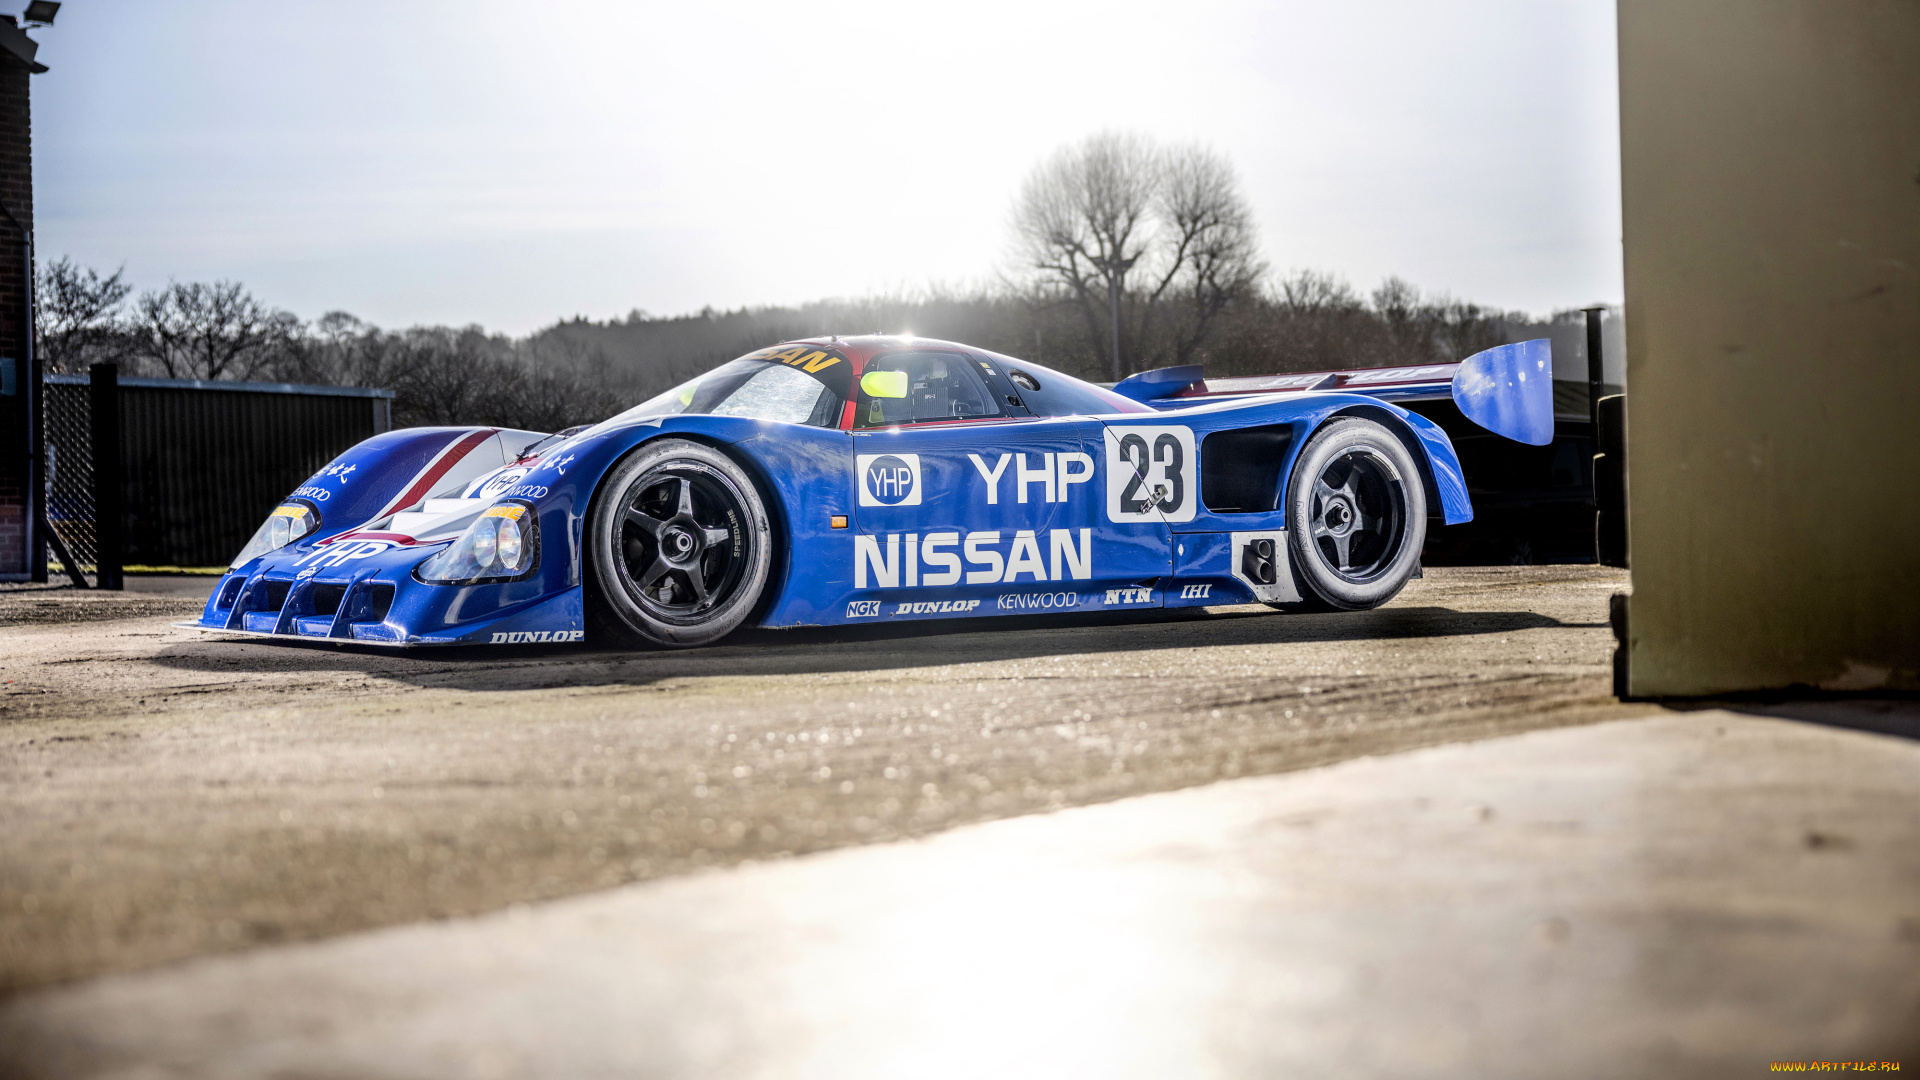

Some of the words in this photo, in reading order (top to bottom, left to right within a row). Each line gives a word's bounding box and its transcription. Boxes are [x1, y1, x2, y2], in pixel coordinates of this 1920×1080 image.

[750, 347, 842, 374] SAN
[1261, 366, 1445, 387] DULOP
[486, 475, 521, 491] YHP
[870, 467, 911, 497] YHP
[967, 452, 1095, 505] YHP
[1119, 433, 1184, 514] 23
[727, 509, 741, 558] SPEEDLINE
[292, 542, 388, 567] YHP
[854, 528, 1092, 589] NISSAN
[997, 592, 1077, 609] KENWOOD
[1104, 588, 1153, 605] NTN
[1180, 584, 1213, 599] IHI
[847, 601, 879, 617] NGK
[895, 599, 981, 615] DUNLOP
[489, 630, 585, 644] DUNLOP
